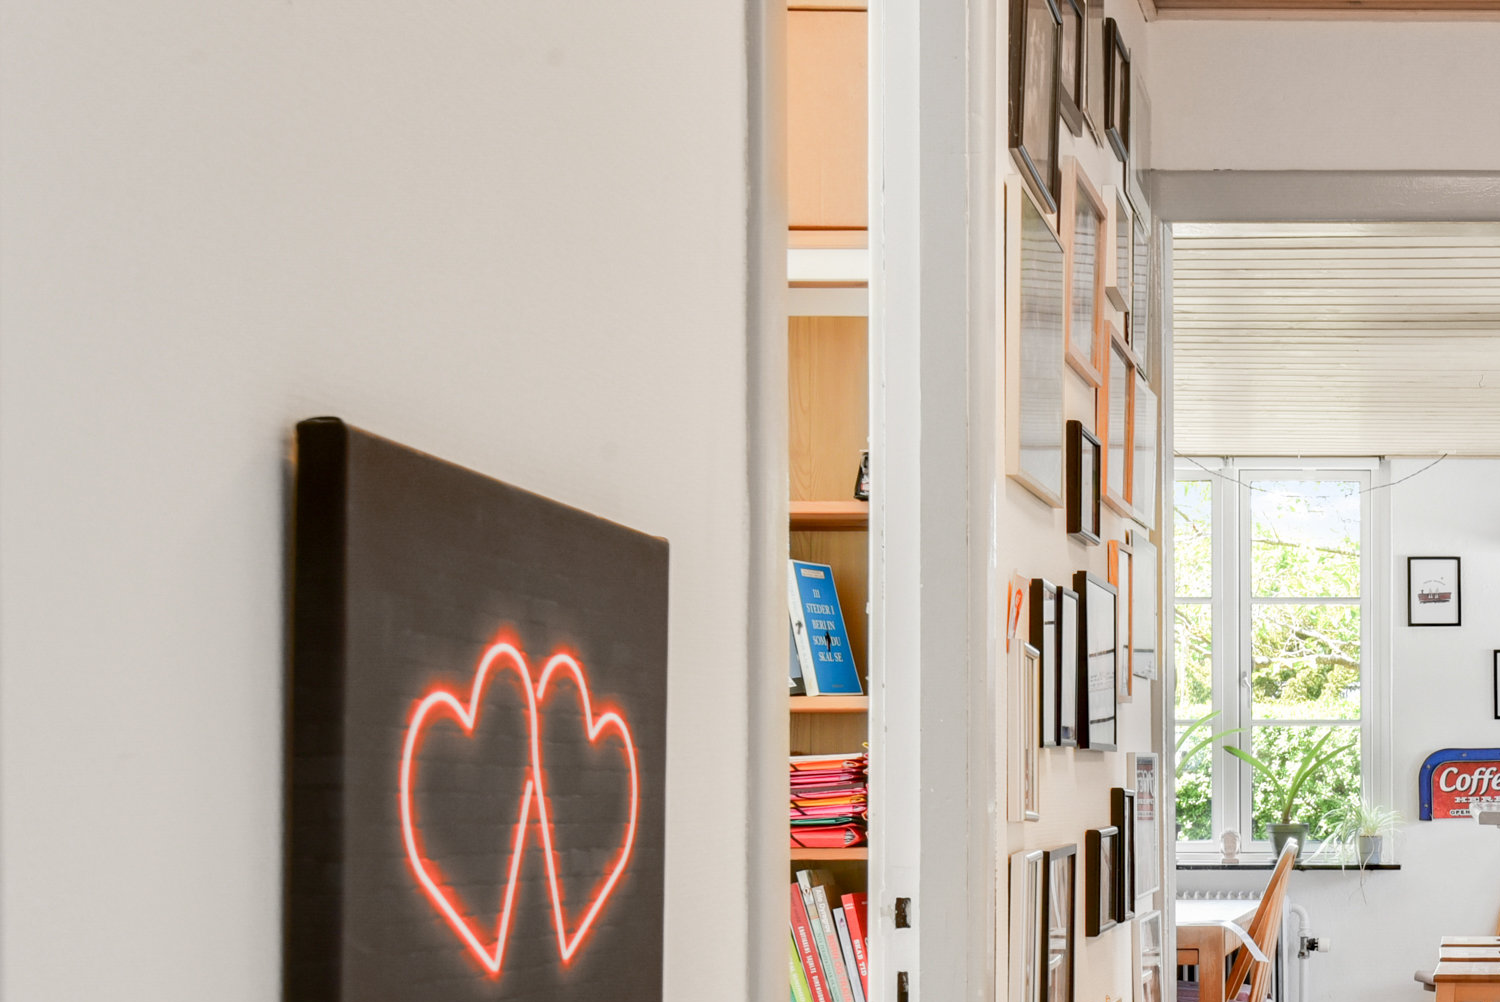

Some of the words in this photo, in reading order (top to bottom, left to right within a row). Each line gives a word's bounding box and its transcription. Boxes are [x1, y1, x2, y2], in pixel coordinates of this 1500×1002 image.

[805, 603, 831, 615] STEDER
[812, 619, 835, 630] BERLIN
[830, 637, 841, 647] DU
[818, 651, 834, 662] SKAL
[834, 652, 843, 662] SE
[859, 959, 867, 976] TID
